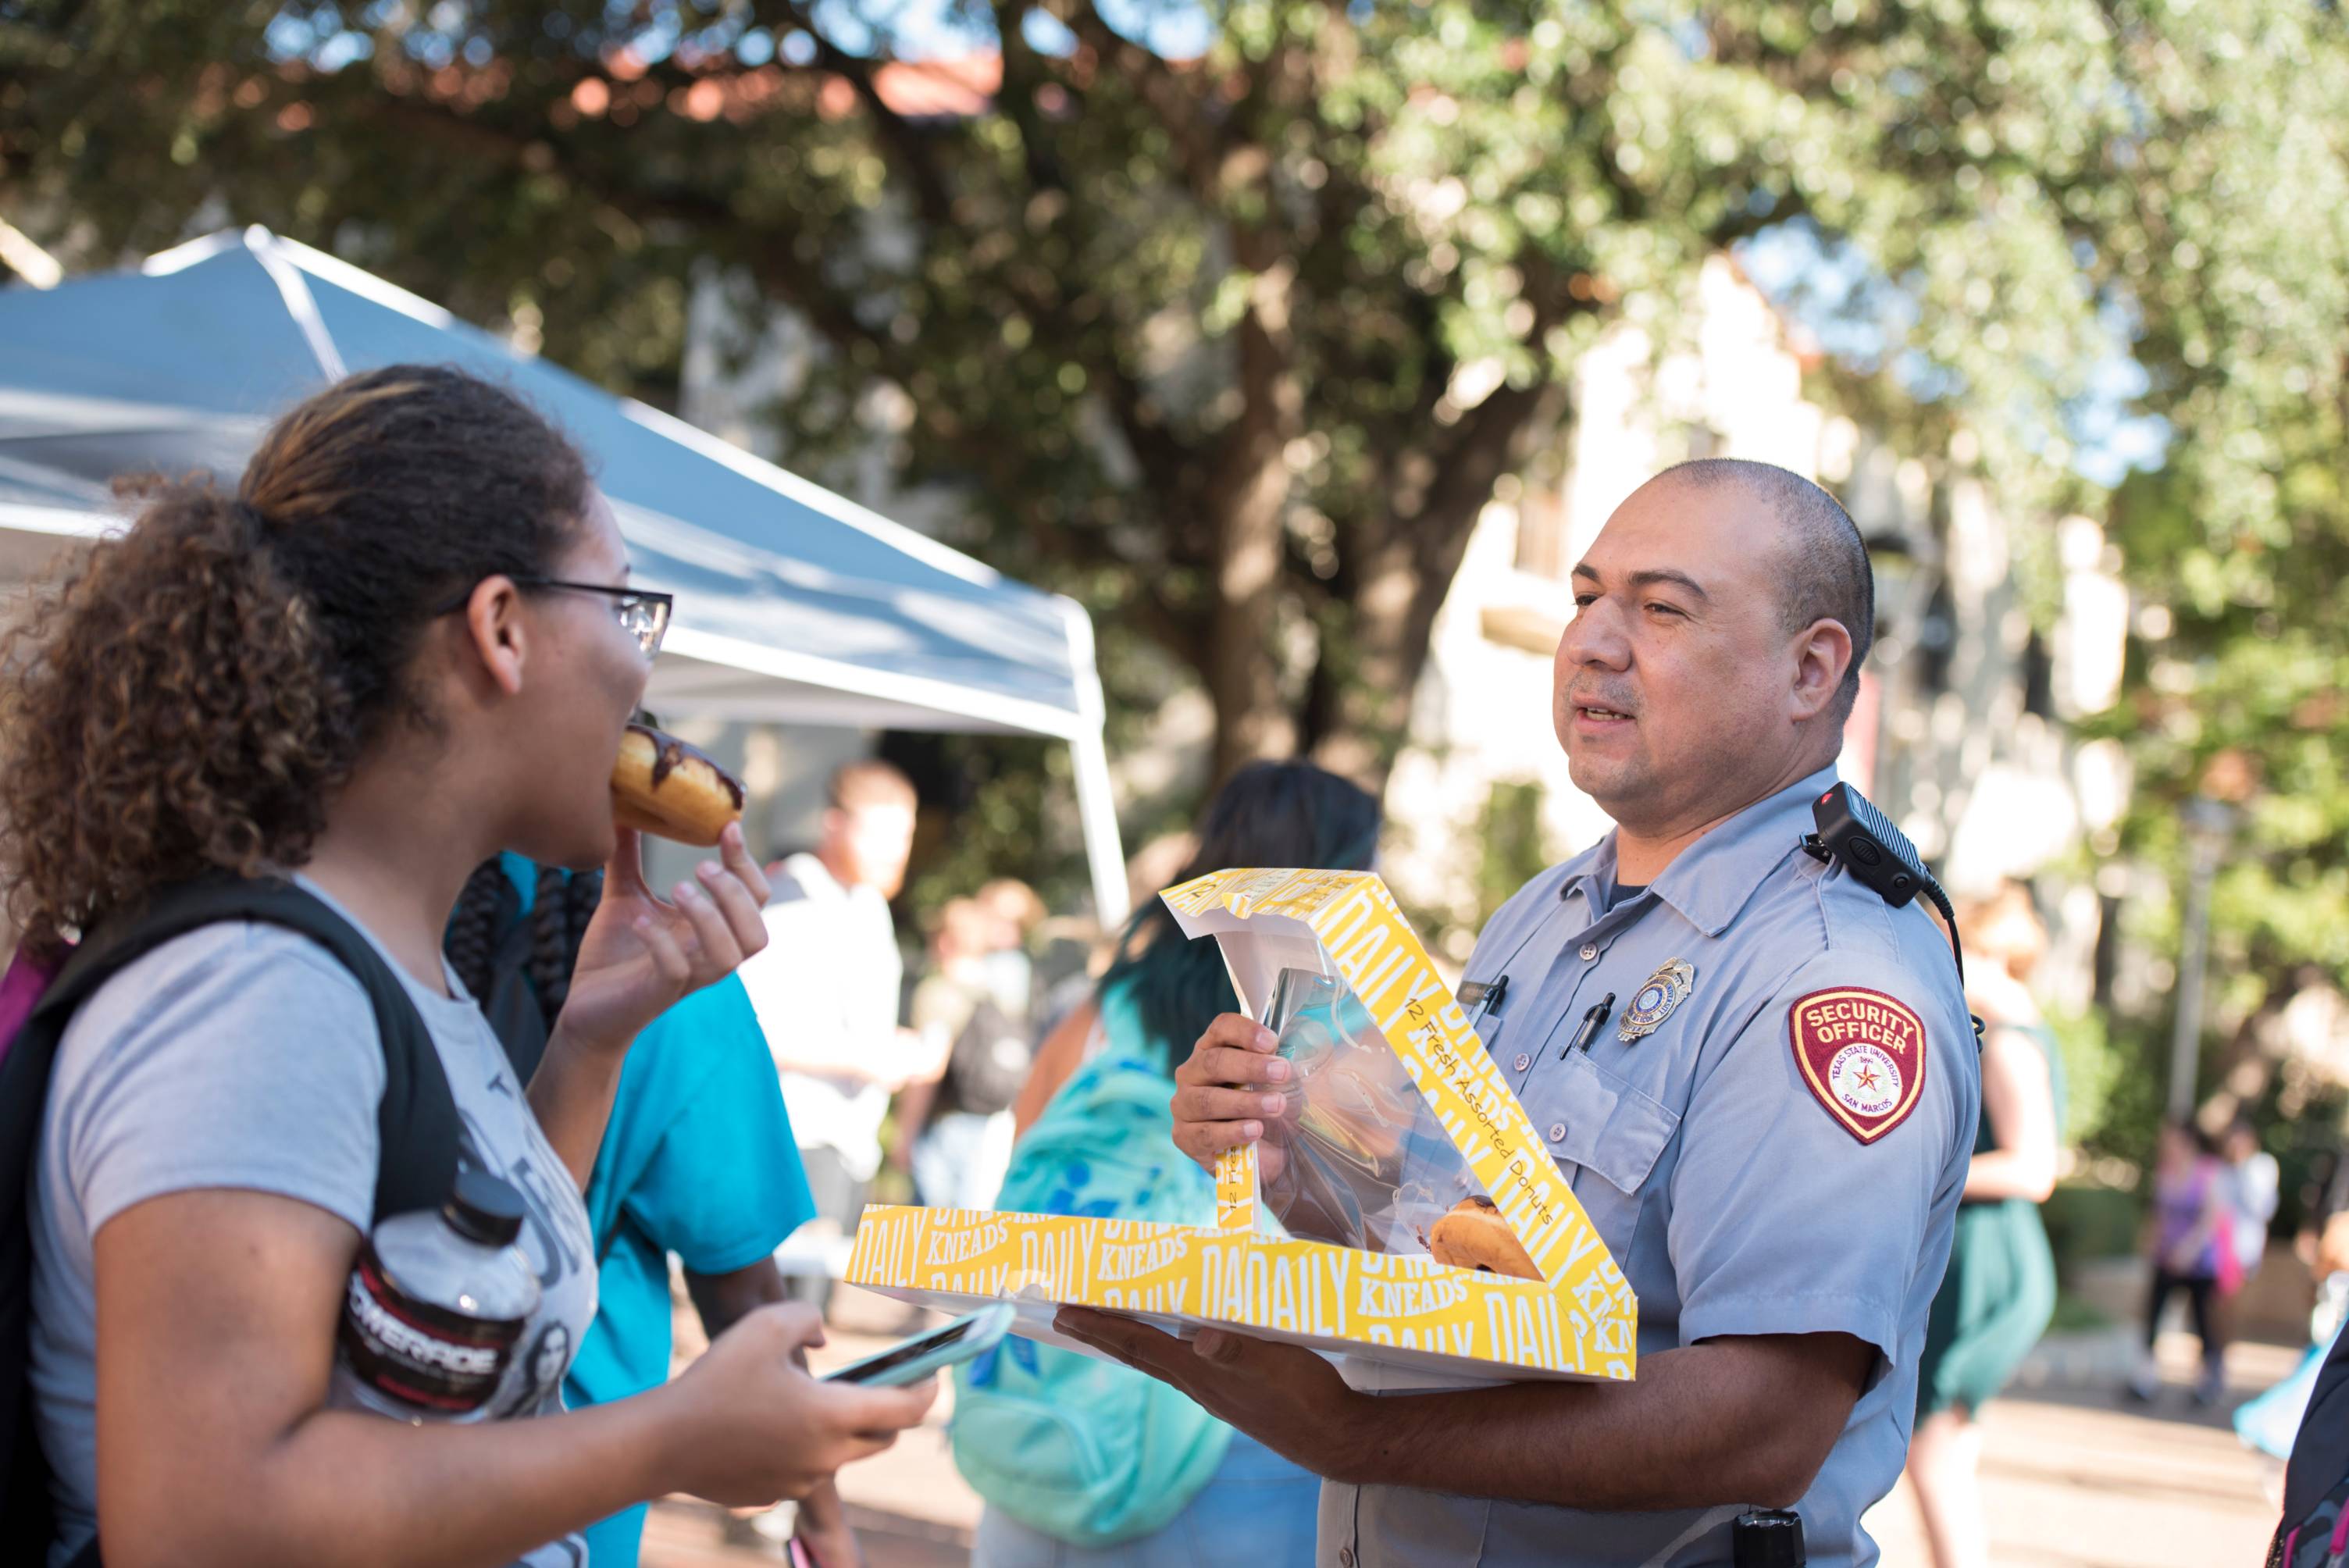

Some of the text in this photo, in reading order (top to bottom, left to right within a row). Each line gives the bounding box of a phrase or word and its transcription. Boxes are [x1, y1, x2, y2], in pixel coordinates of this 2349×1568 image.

[1805, 1003, 1915, 1039] SECURITY
[1816, 1021, 1907, 1054] OFFICER
[1406, 1014, 1513, 1132] KNEADS
[1832, 1046, 1899, 1088] TEXAS STATE UNIVERSITY
[1404, 997, 1425, 1021] 12
[1420, 1021, 1456, 1077] Fresh
[1455, 1079, 1516, 1160] Assorted
[1509, 1160, 1554, 1227] Donuts
[1842, 1093, 1892, 1113] SAN MARCOS
[1228, 1146, 1237, 1184] Fres
[1488, 1147, 1600, 1289] DAILY
[852, 1207, 929, 1287] DAILY
[925, 1219, 1009, 1265] KNEADS
[1018, 1219, 1098, 1303] DAILY
[1097, 1231, 1188, 1281] KNEADS
[1245, 1248, 1351, 1338] DAILY
[1356, 1274, 1468, 1318] KNEADS
